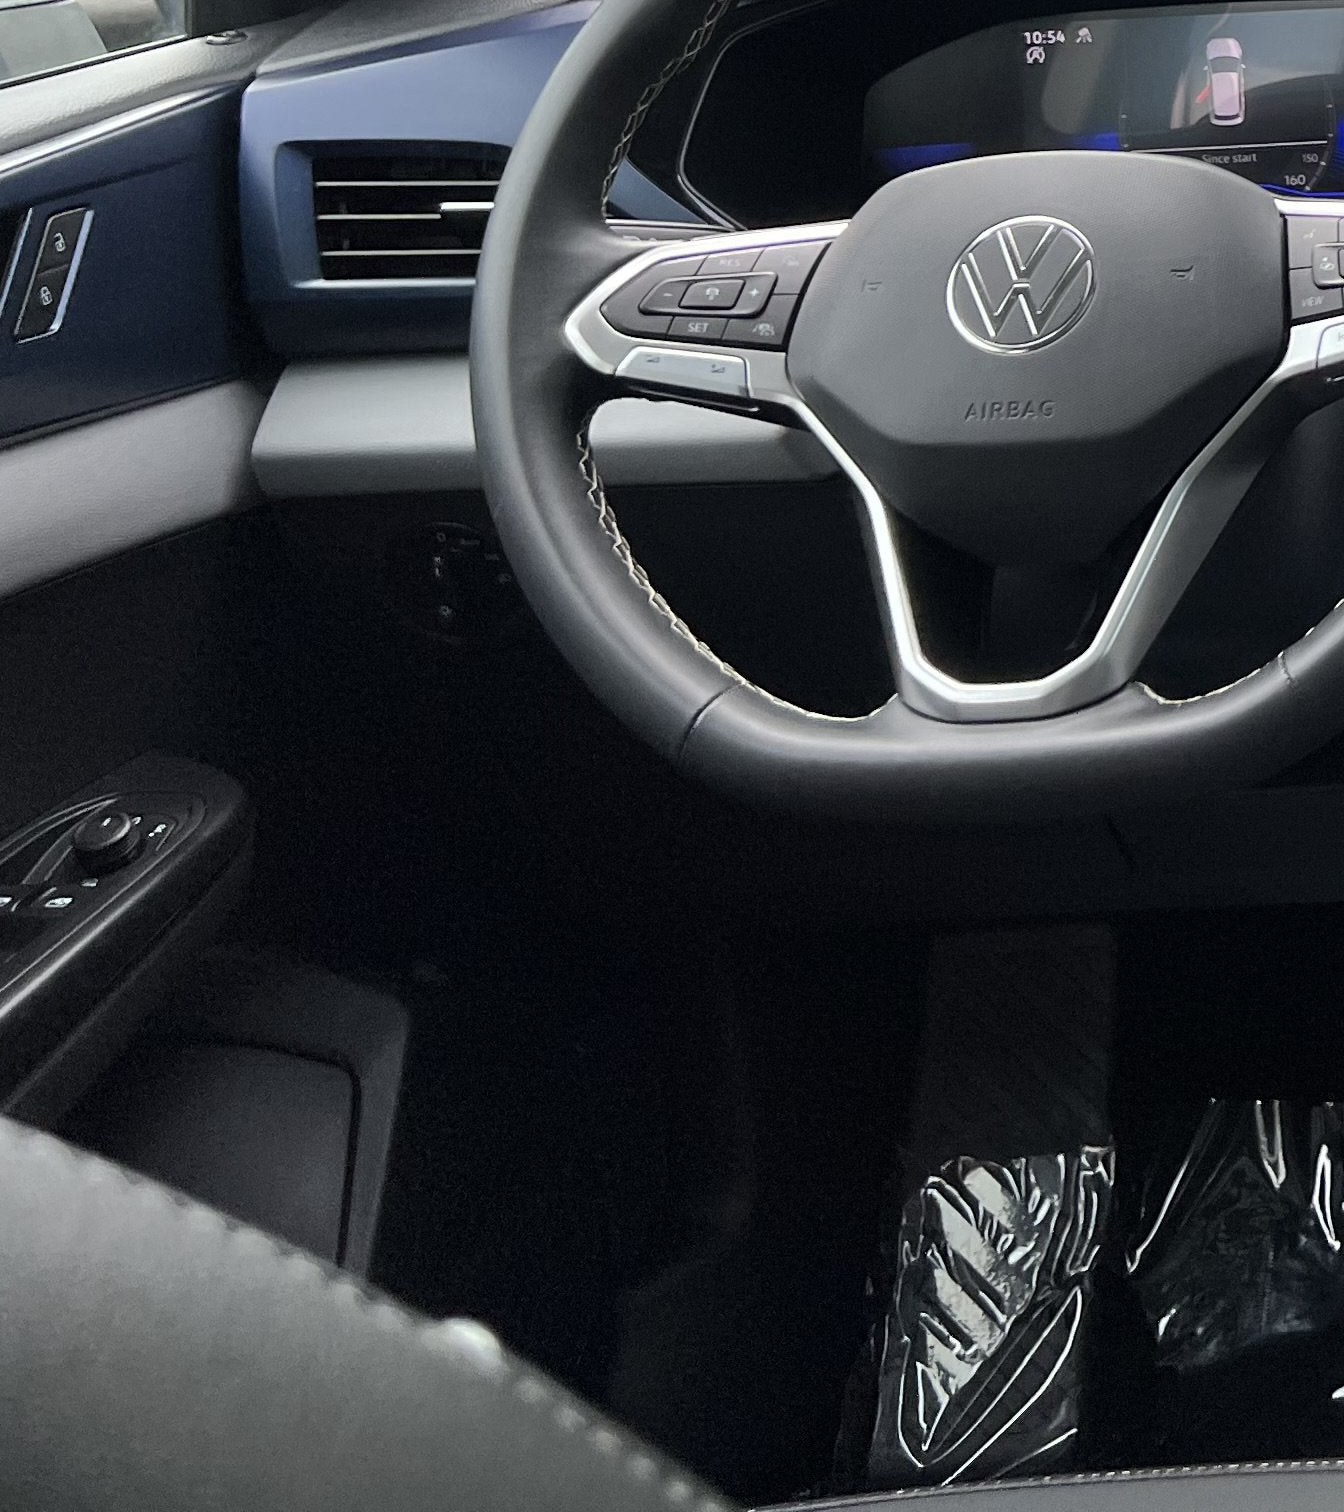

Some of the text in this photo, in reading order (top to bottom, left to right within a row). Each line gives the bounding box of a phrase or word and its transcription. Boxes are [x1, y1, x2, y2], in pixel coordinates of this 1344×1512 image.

[1023, 30, 1066, 44] 10:54
[1202, 153, 1257, 164] Since start
[1302, 153, 1318, 163] 150
[1284, 174, 1306, 185] 160
[687, 322, 709, 334] SET
[964, 399, 1056, 422] AIRBAG
